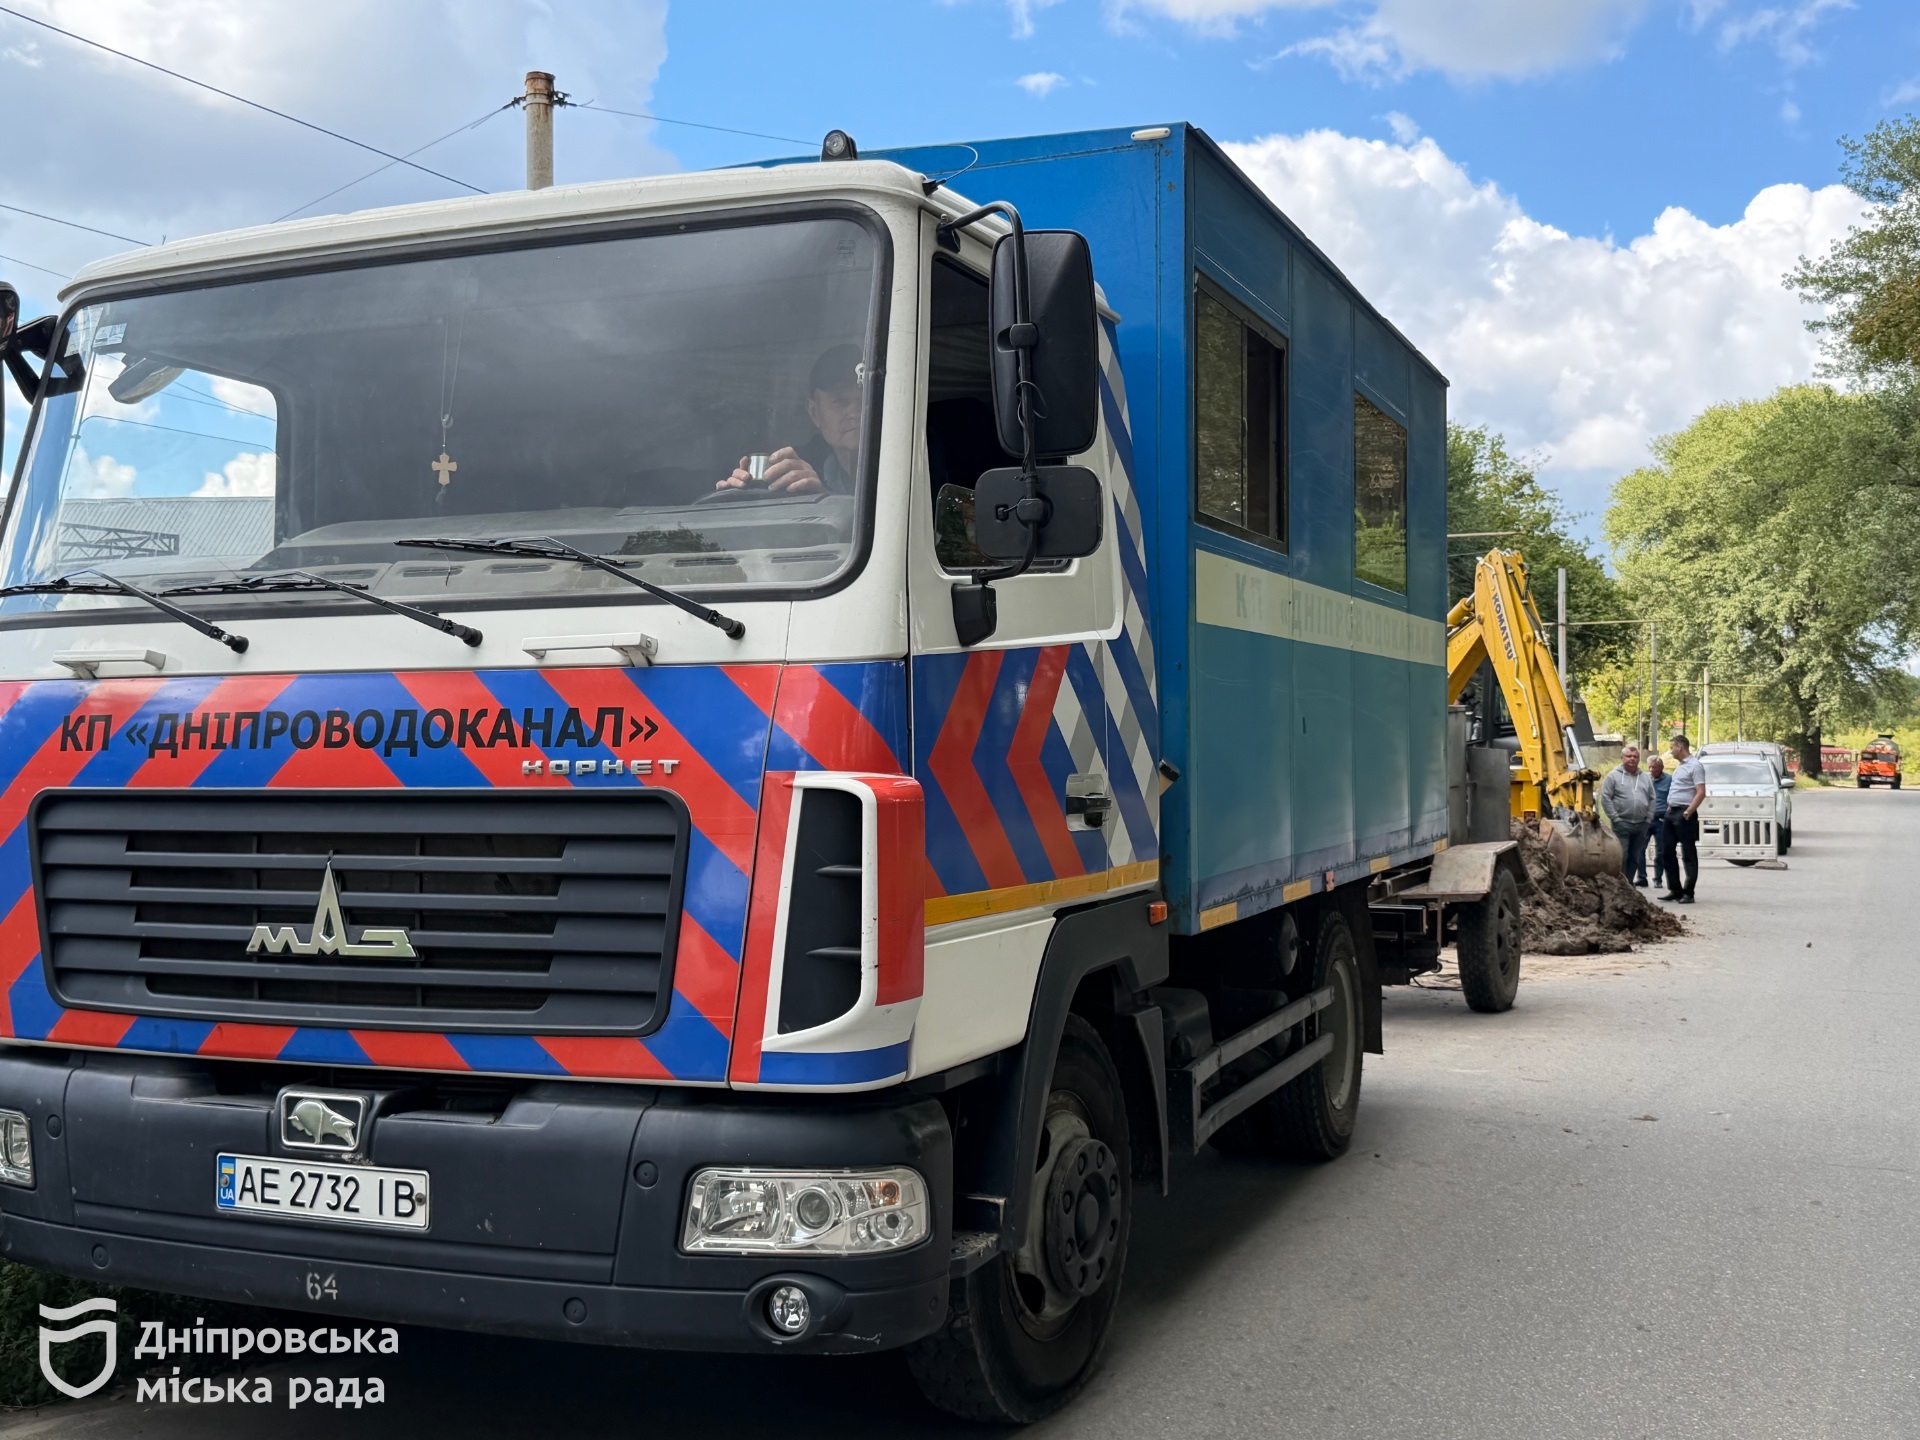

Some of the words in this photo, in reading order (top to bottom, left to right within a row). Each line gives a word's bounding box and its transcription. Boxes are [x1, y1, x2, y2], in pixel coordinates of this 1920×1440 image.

[1491, 592, 1514, 660] KOMATSU
[60, 714, 112, 751] КП
[125, 706, 659, 759] «ДНІПРОВОДОКАНАЛ»
[522, 759, 681, 775] КОРНЕТ
[220, 1188, 235, 1200] UA
[289, 1171, 360, 1213] 2732
[306, 1272, 338, 1300] 64
